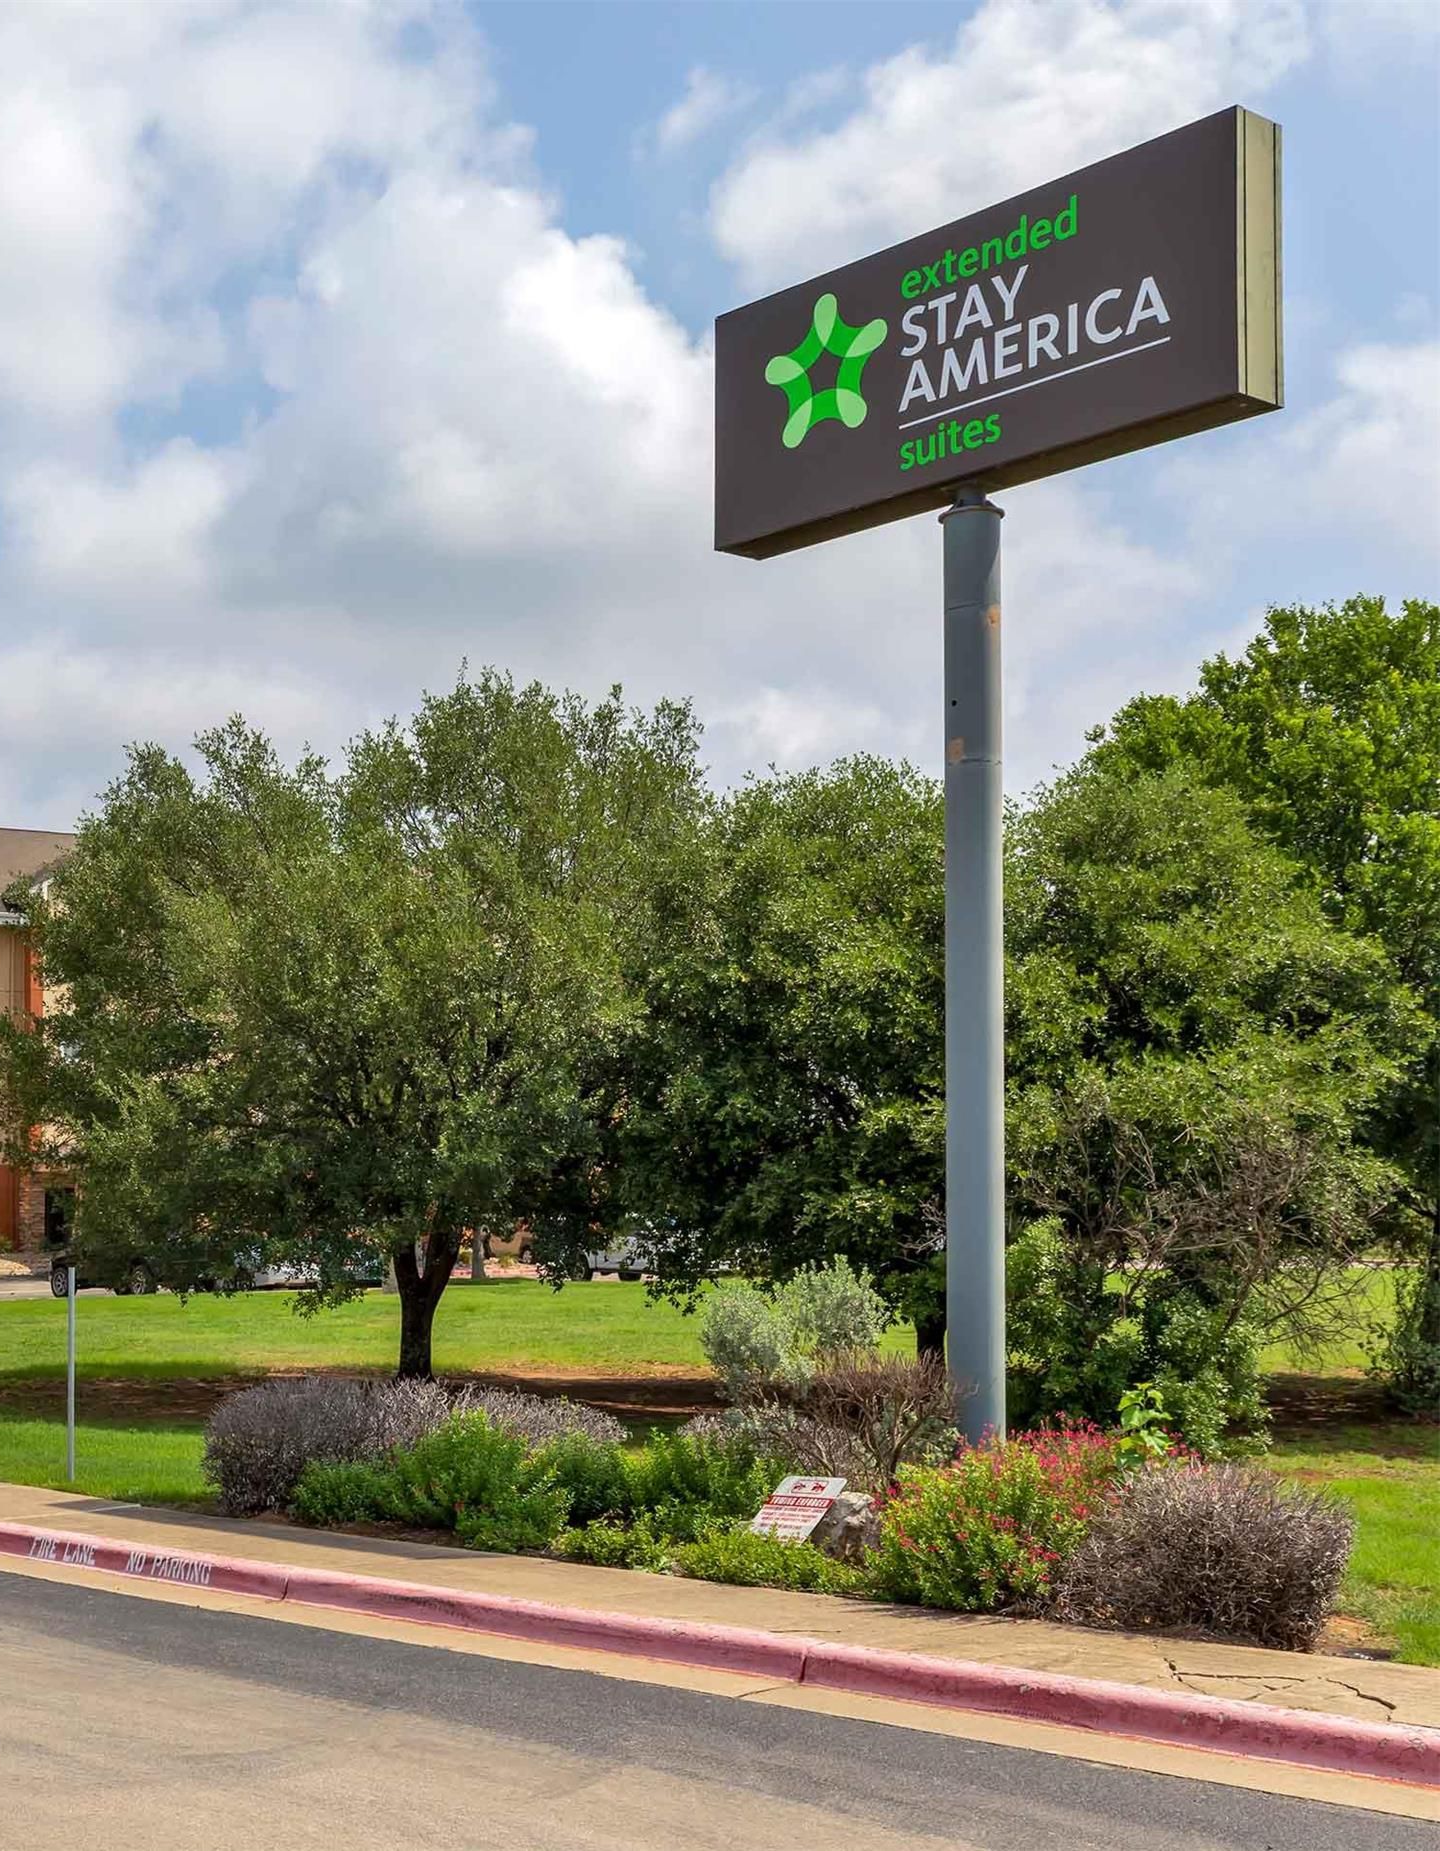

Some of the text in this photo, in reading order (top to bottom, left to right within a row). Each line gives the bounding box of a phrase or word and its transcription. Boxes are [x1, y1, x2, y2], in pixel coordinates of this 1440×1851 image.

[900, 194, 1078, 300] extended
[898, 276, 1171, 413] AMERICA
[900, 264, 1030, 357] STAY
[899, 413, 1001, 471] suites
[29, 1535, 212, 1584] FIRE LANE NO PARKING
